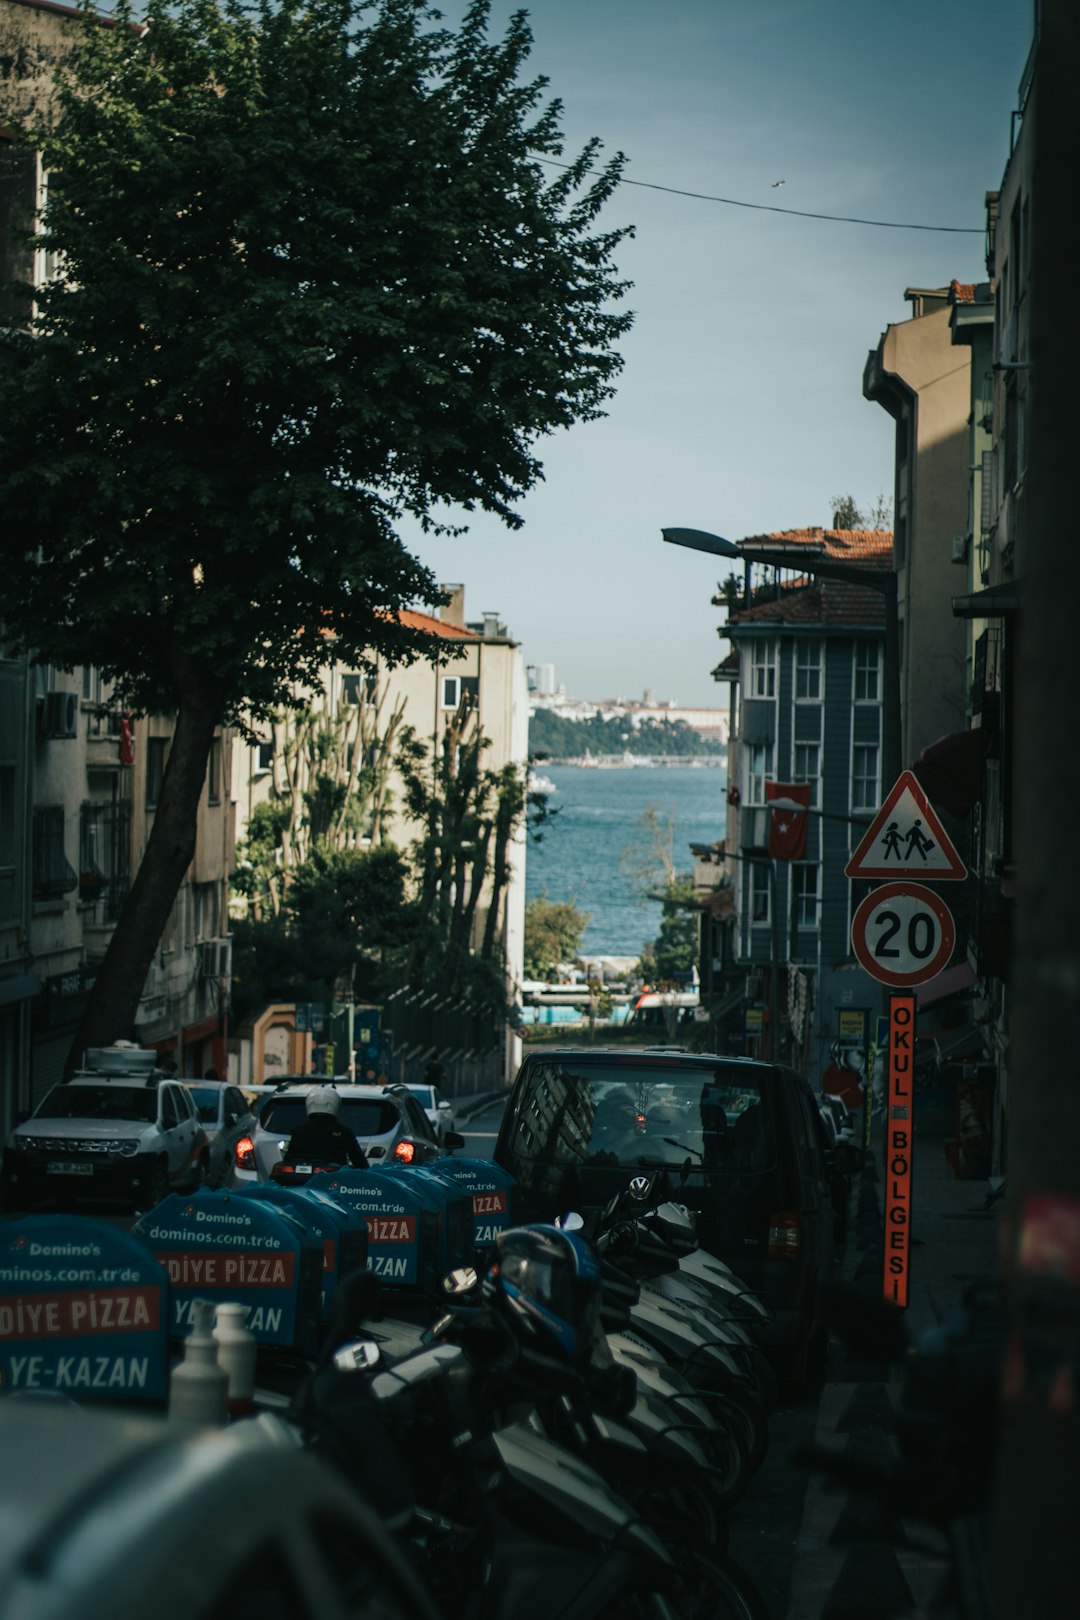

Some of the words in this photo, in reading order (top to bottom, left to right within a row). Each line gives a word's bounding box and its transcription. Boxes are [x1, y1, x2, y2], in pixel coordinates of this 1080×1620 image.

[874, 911, 935, 959] 20
[893, 1006, 911, 1097] OKUL
[339, 1185, 383, 1197] Domino's
[195, 1211, 252, 1226] Domino's
[348, 1201, 405, 1214] .com.tr'de
[889, 1131, 908, 1301] BÖLGESİ
[29, 1242, 102, 1257] Domino's
[149, 1225, 281, 1249] dominos.com.tr'de
[225, 1255, 286, 1284] PİZZA
[71, 1292, 151, 1331] PİZZA
[9, 1355, 149, 1388] YE-KAZAN
